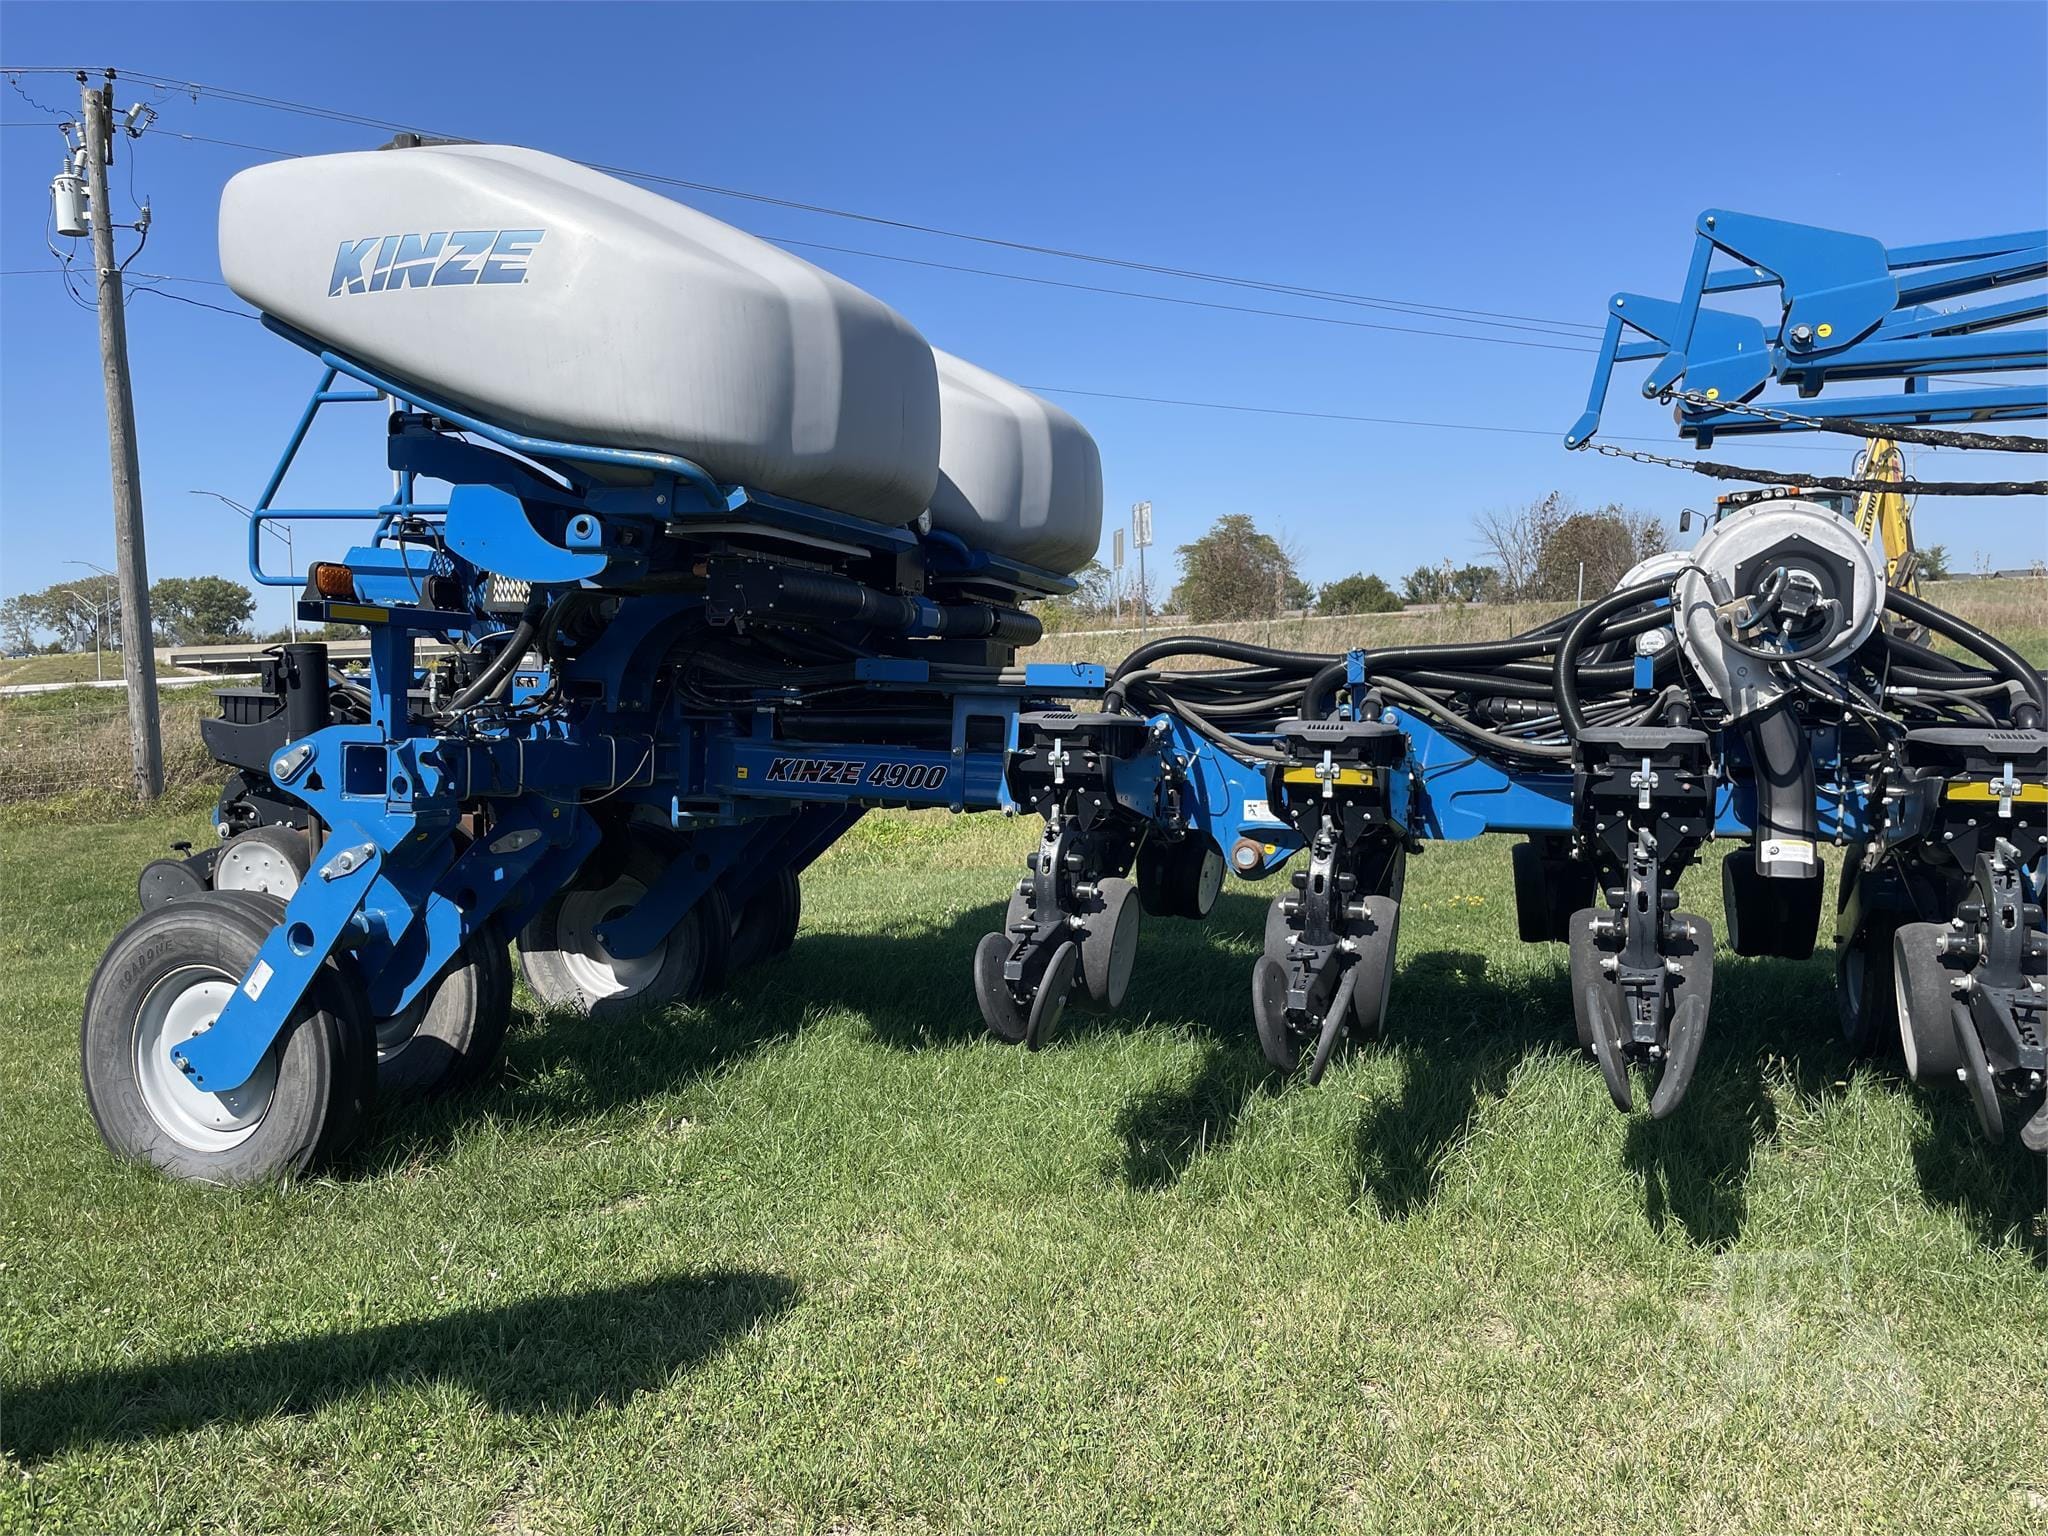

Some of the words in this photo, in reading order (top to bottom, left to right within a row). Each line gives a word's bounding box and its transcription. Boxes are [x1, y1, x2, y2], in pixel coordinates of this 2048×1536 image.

[328, 229, 547, 298] KINZE
[1864, 494, 1877, 540] OLLAND
[765, 757, 866, 786] KINZE
[866, 762, 948, 790] 4900
